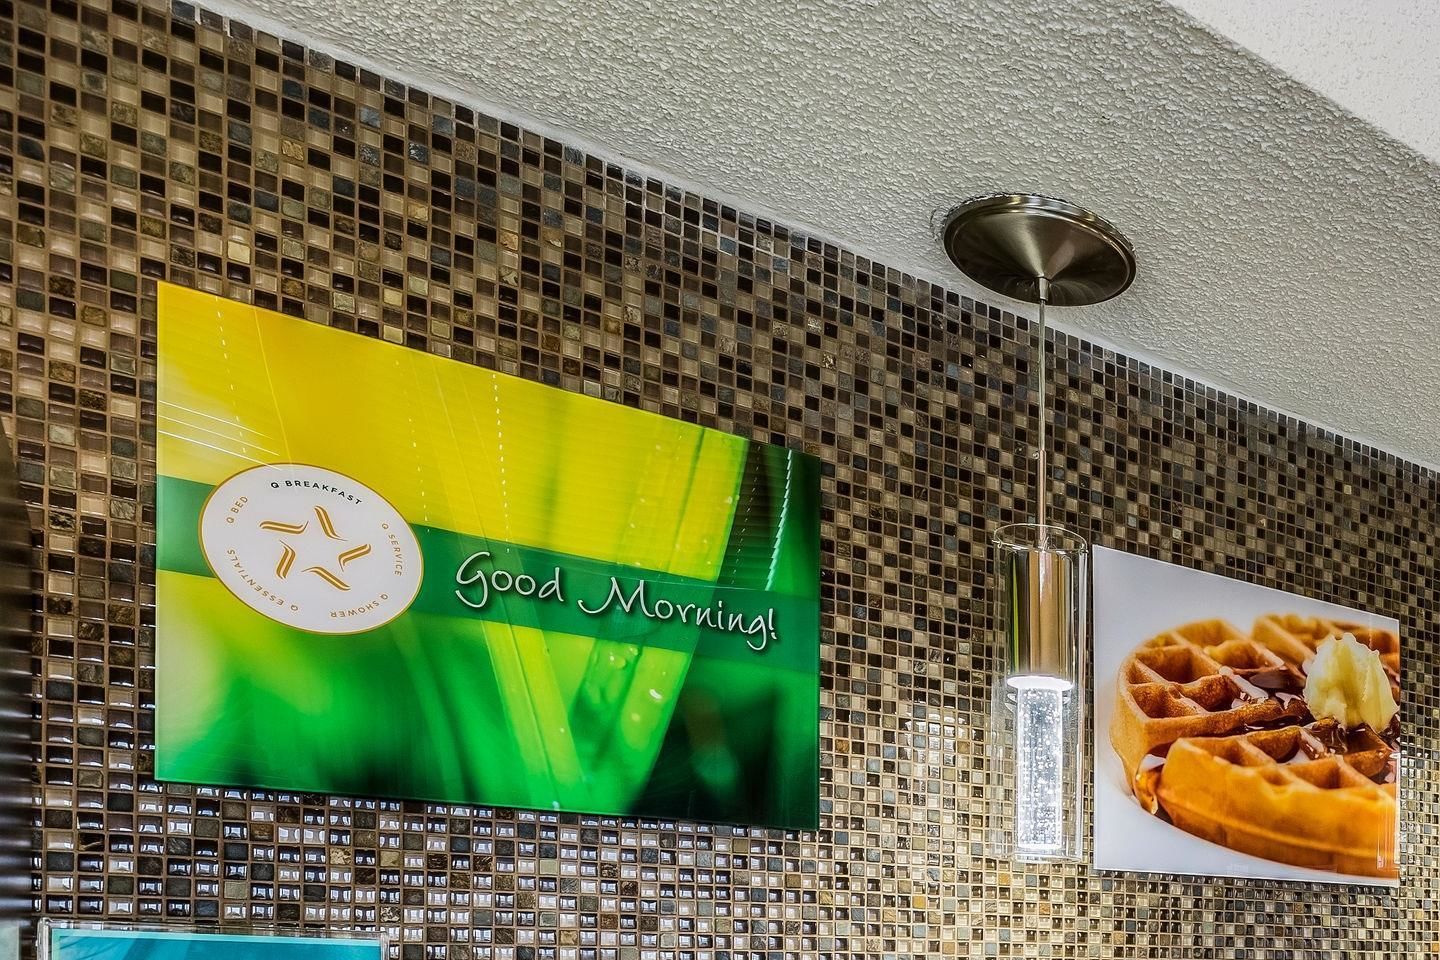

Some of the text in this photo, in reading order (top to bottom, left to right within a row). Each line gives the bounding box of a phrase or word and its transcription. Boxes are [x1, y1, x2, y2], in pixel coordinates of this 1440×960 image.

[230, 495, 249, 514] BED
[270, 479, 363, 505] Q BREAKFAST
[387, 533, 402, 577] SERVICE
[226, 548, 284, 606] ESSENTIALS
[330, 600, 380, 618] SHOWER
[454, 551, 778, 651] Good Morning!
